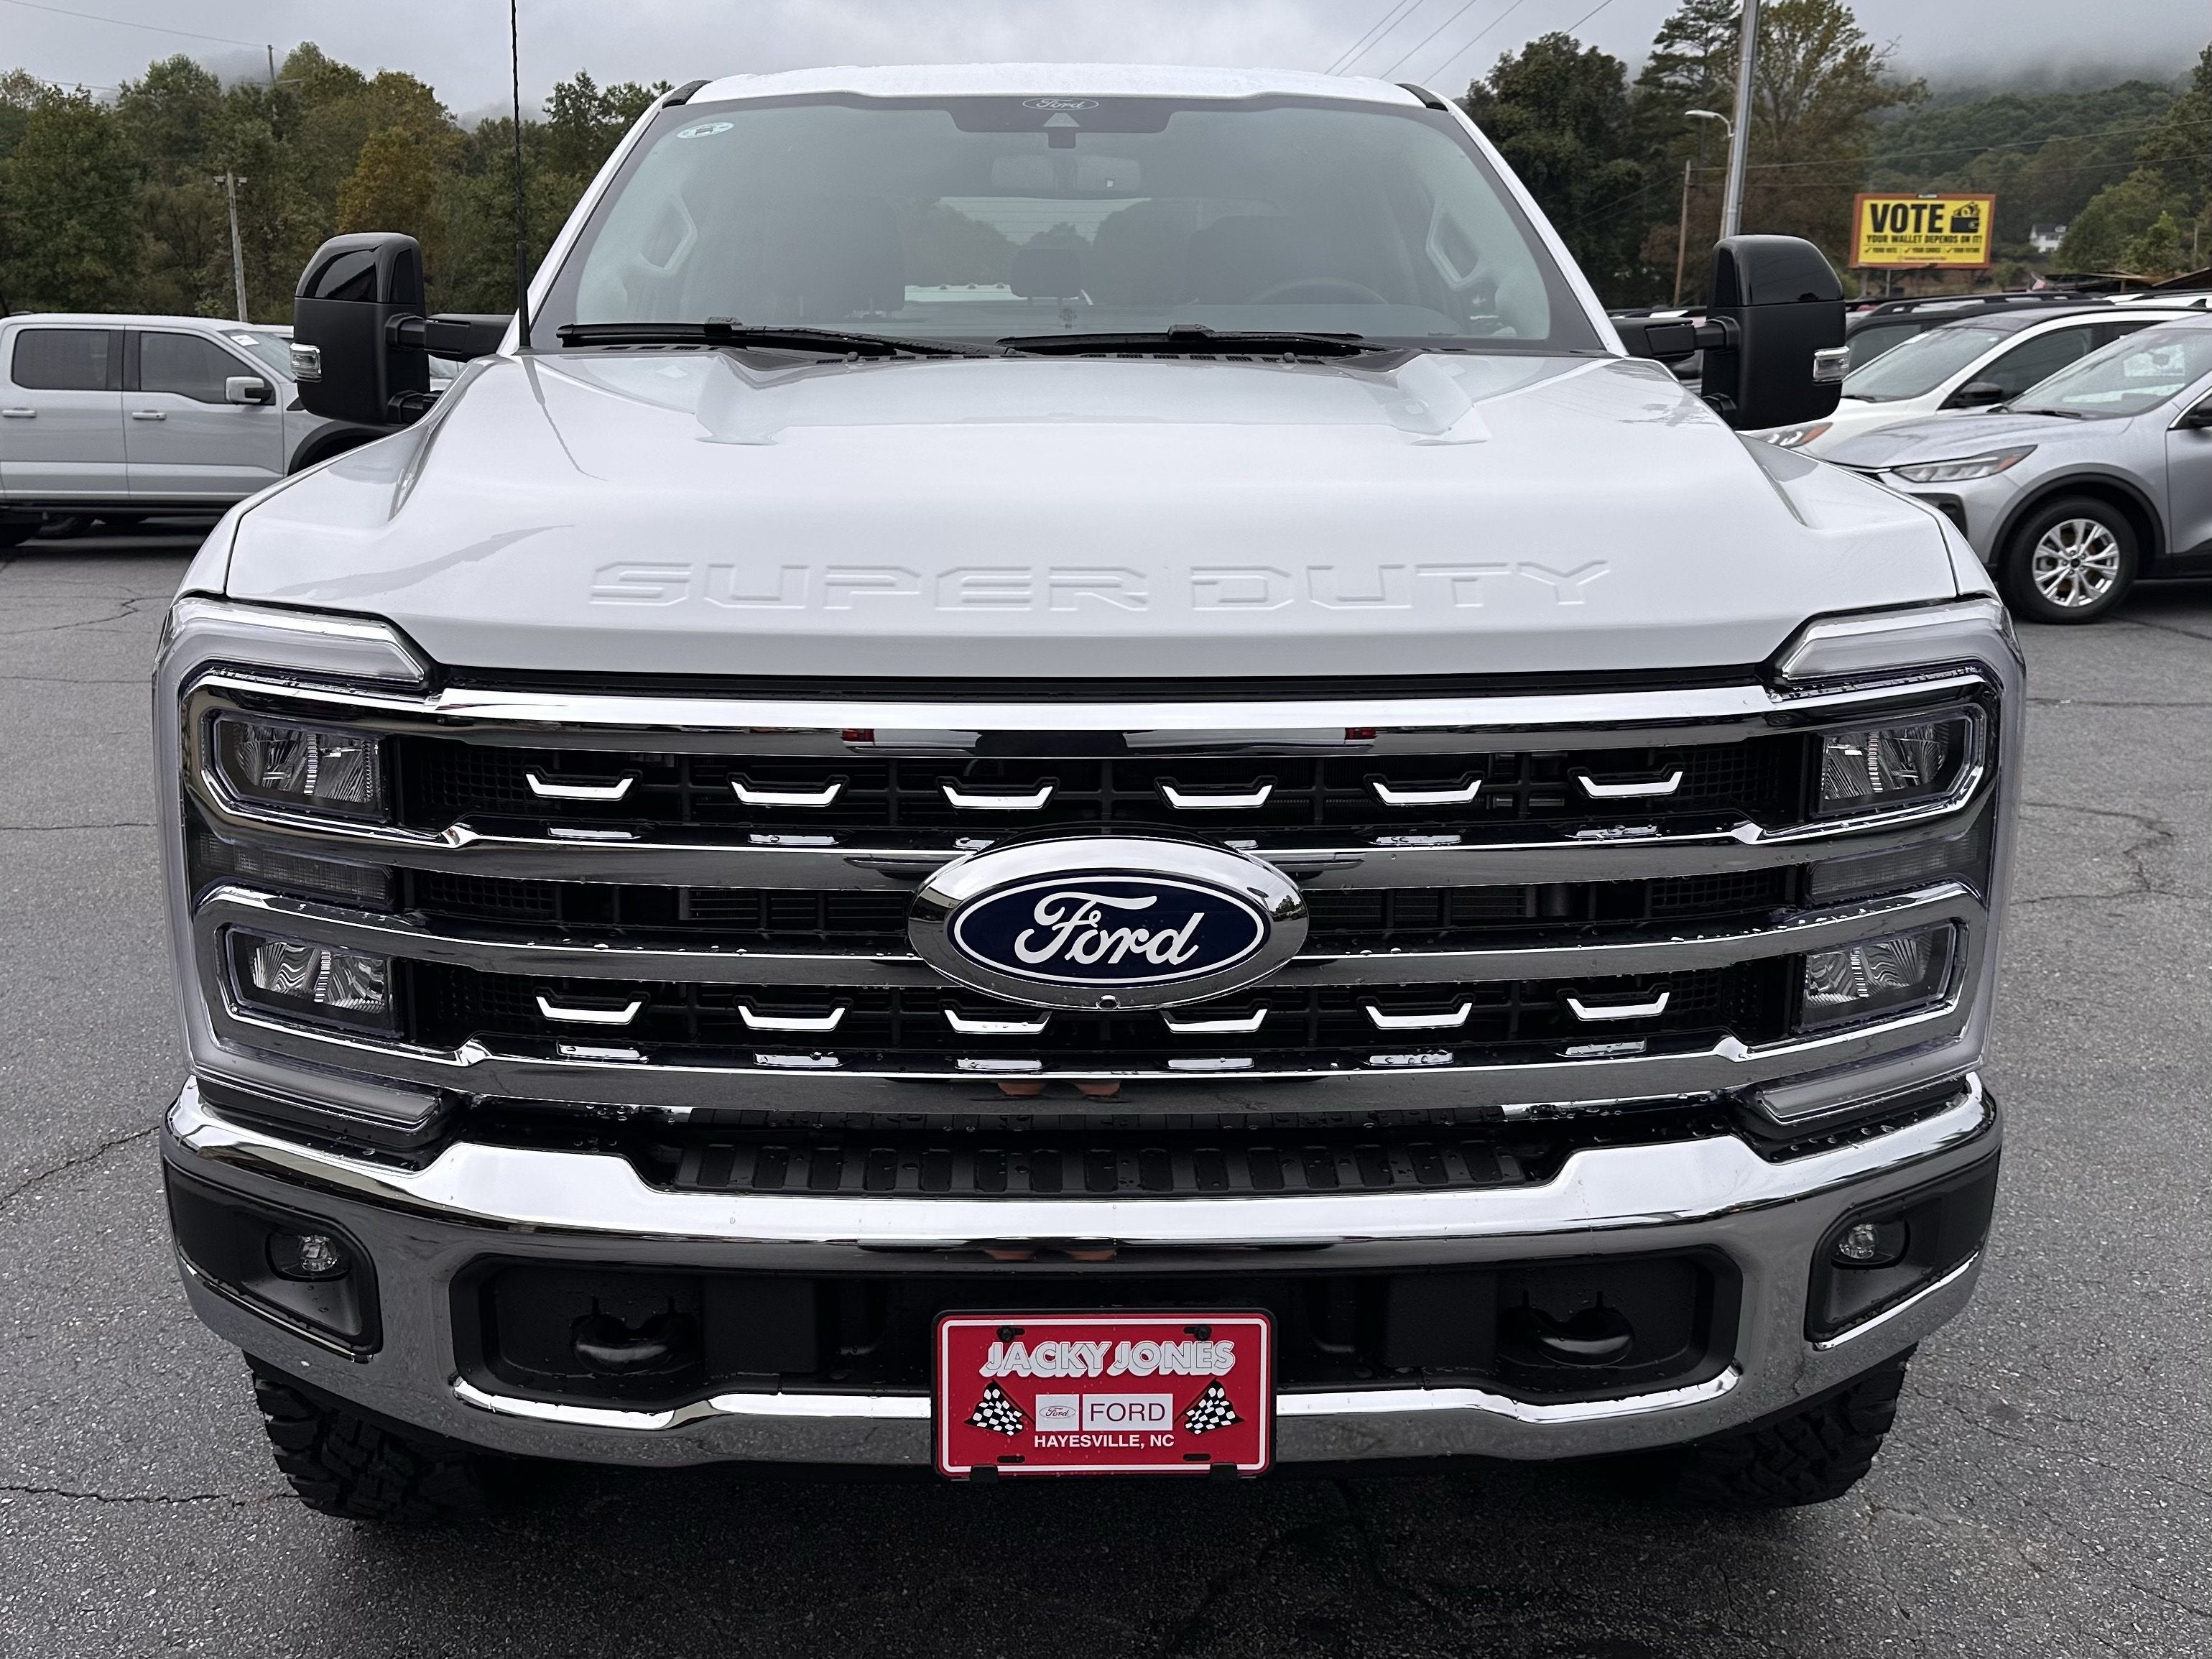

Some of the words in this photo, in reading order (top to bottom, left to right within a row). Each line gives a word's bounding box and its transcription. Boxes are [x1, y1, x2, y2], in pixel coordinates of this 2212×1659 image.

[1036, 98, 1085, 108] Ford
[1870, 203, 1945, 234] VOTE
[589, 561, 1149, 611] SUPER
[1191, 560, 1611, 611] DUTY
[1014, 891, 1205, 966] Ford
[978, 1340, 1113, 1378] JACKY
[1106, 1340, 1236, 1377] JONES
[1045, 1405, 1070, 1418] Ford
[1090, 1402, 1166, 1422] FORD
[1034, 1434, 1144, 1450] HAYESVILLE,
[1149, 1433, 1175, 1448] NC
